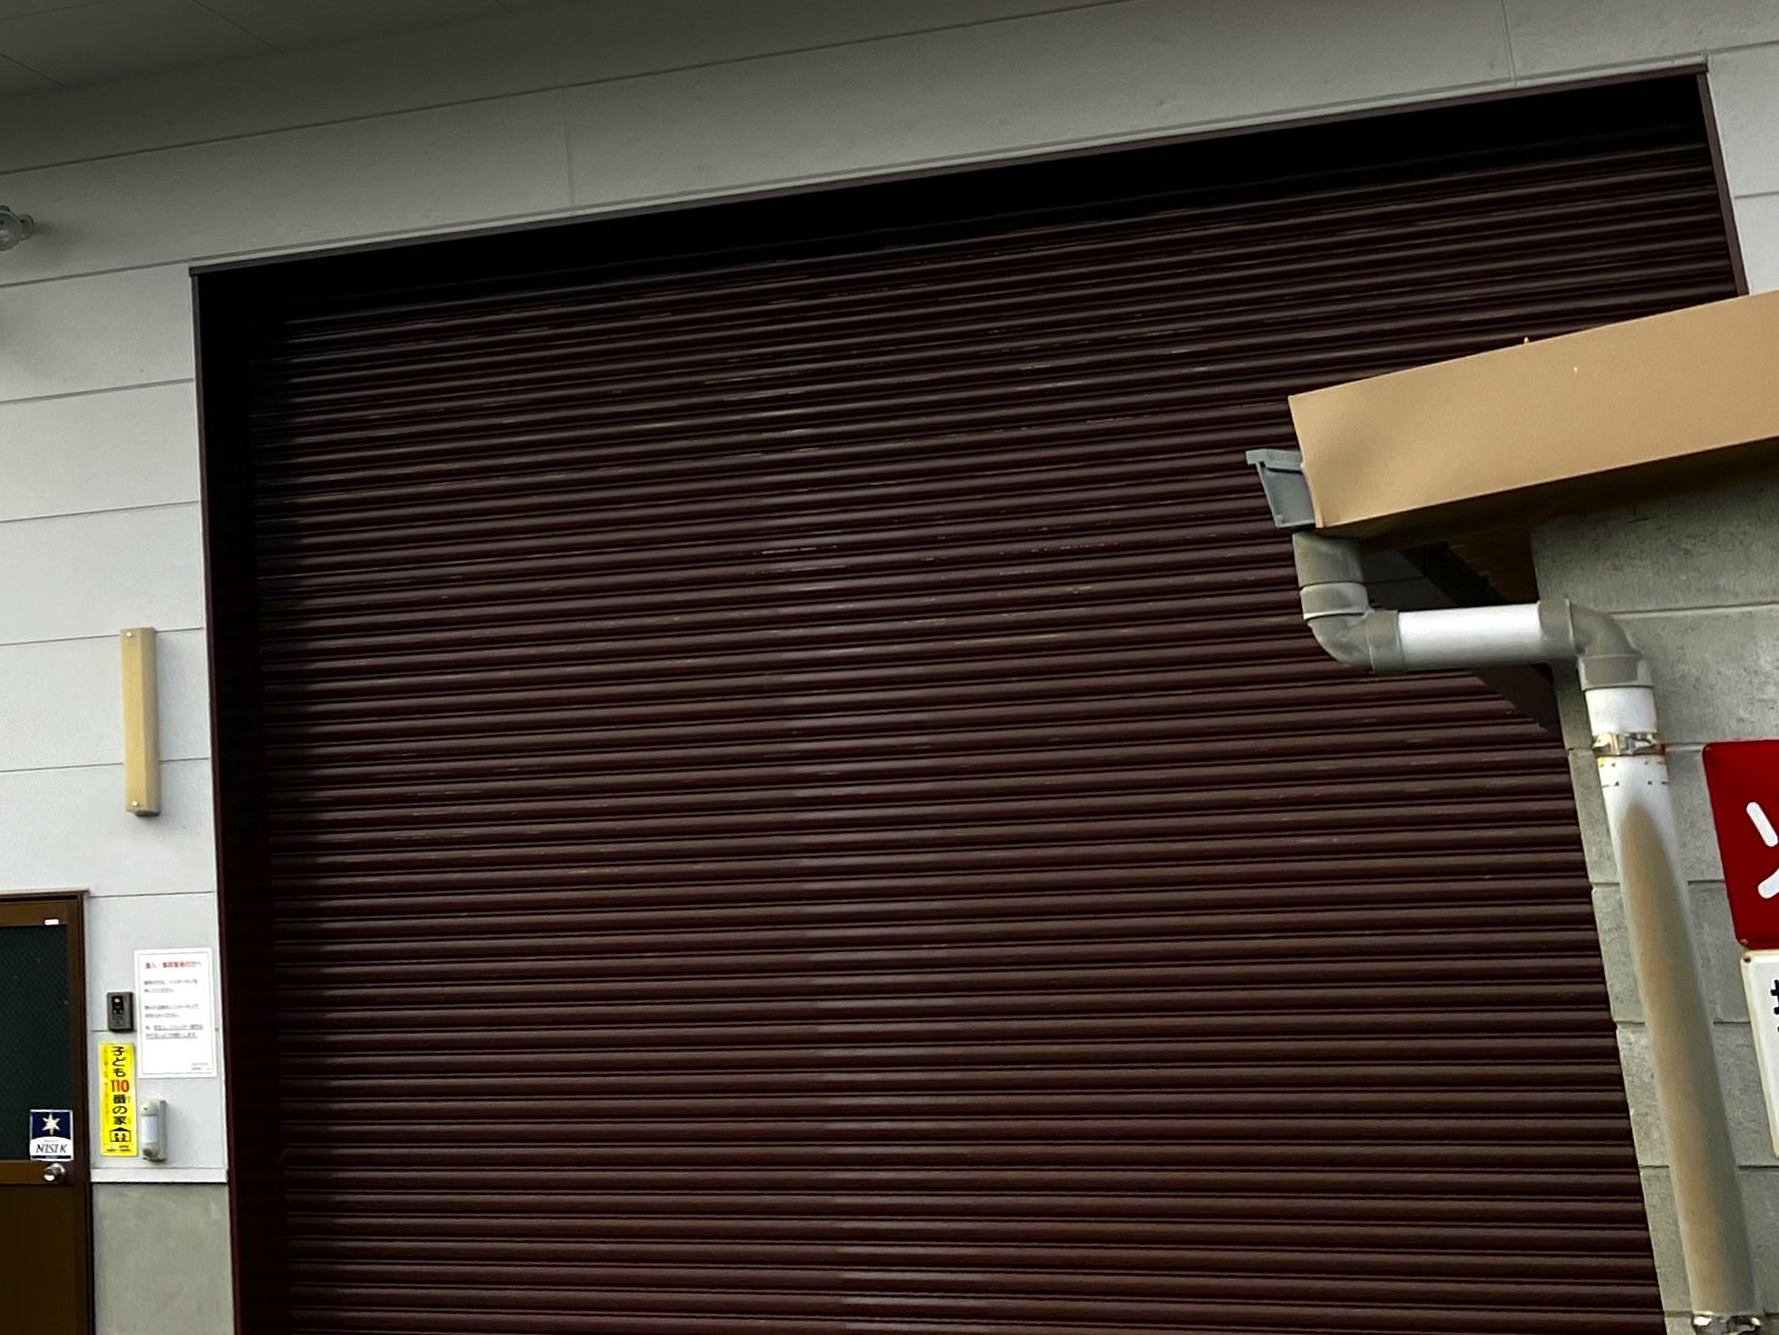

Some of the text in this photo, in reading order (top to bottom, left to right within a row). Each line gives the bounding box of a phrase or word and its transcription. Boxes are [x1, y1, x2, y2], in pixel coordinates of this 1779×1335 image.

[110, 1046, 130, 1125] 子ども110番の家
